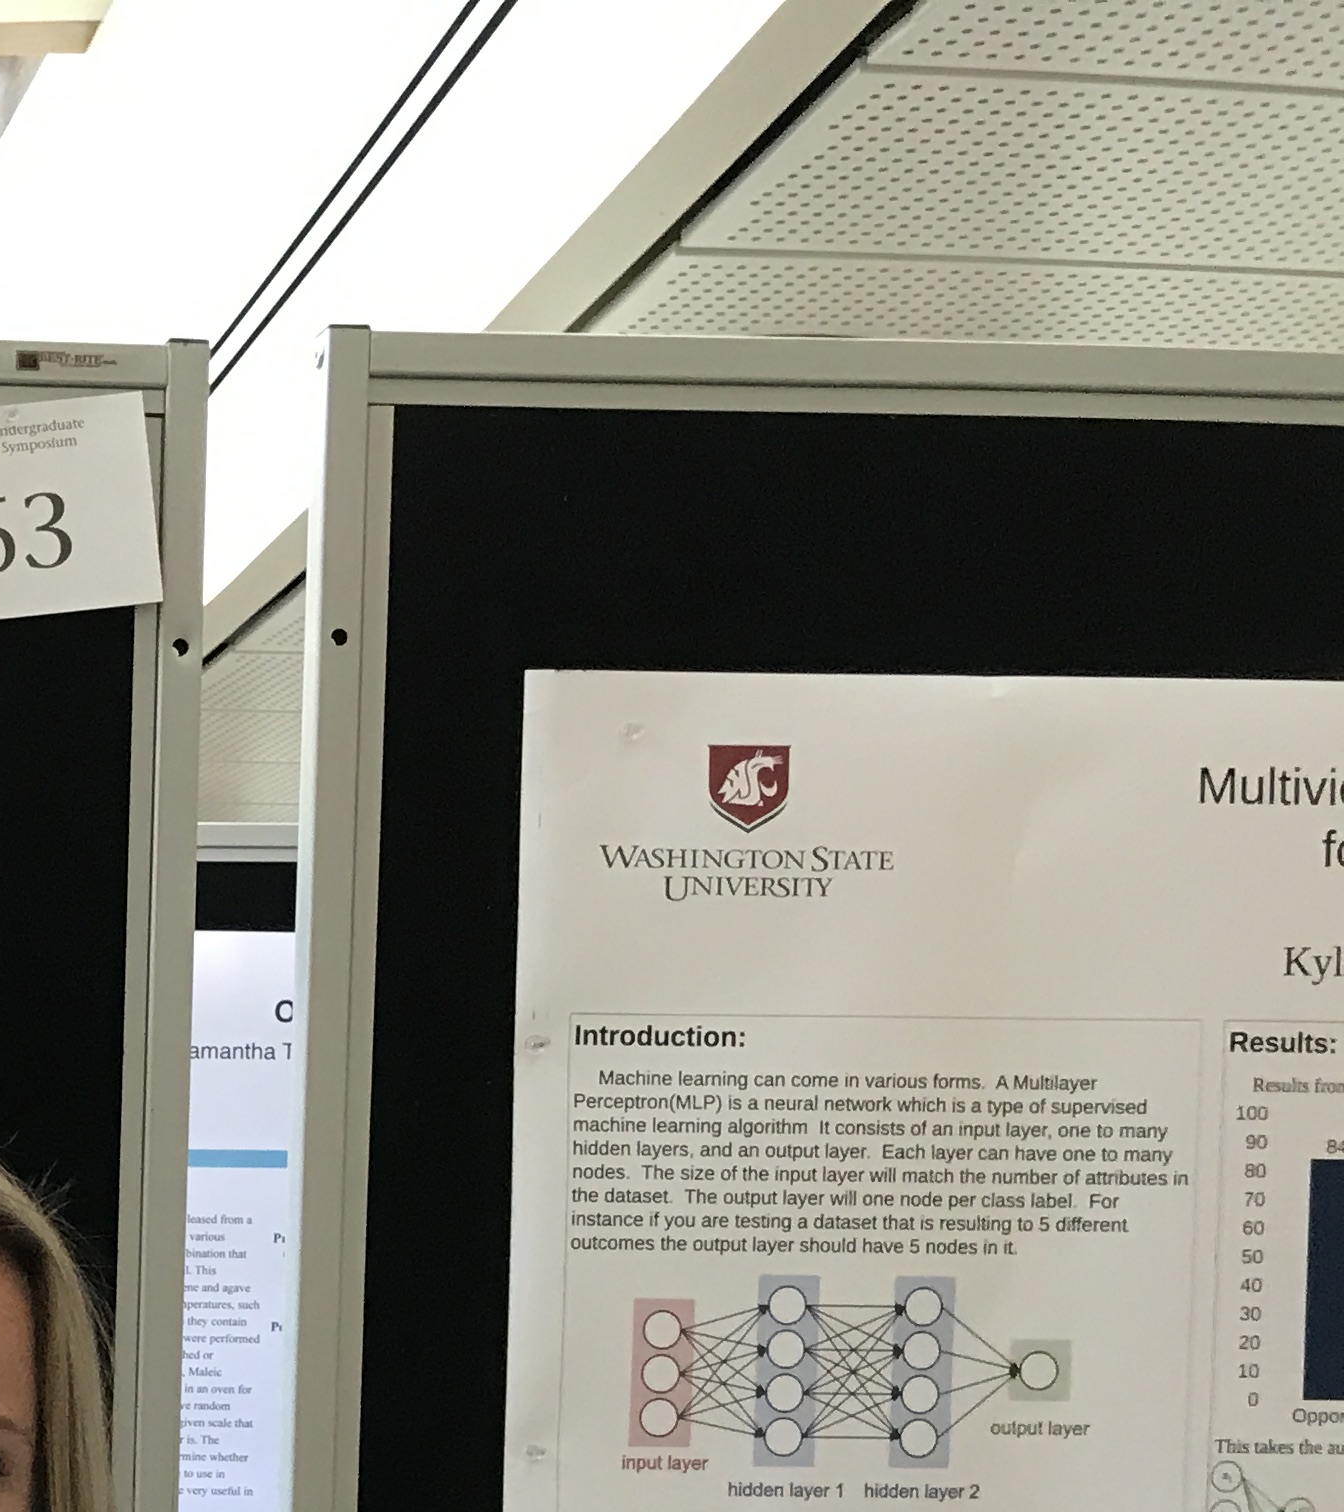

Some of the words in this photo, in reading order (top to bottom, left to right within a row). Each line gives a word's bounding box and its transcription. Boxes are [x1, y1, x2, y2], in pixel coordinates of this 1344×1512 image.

[1, 434, 78, 456] Symposium
[1198, 766, 1344, 807] Multivi
[599, 844, 805, 872] WASHINGTON
[811, 845, 895, 873] STATE
[663, 875, 834, 902] UNIVERSITY
[573, 1024, 747, 1050] Introduction:
[1228, 1031, 1338, 1055] Results:
[190, 1042, 276, 1061] amantha
[209, 1332, 260, 1348] performed
[989, 1420, 1042, 1438] output
[1047, 1421, 1091, 1439] layer
[621, 1454, 663, 1474] input
[667, 1455, 709, 1474] layer
[727, 1481, 784, 1498] hidden
[789, 1482, 831, 1501] layer
[835, 1484, 844, 1498] 1
[864, 1482, 919, 1499] hidden
[924, 1482, 966, 1502] layer
[969, 1484, 980, 1499] 2
